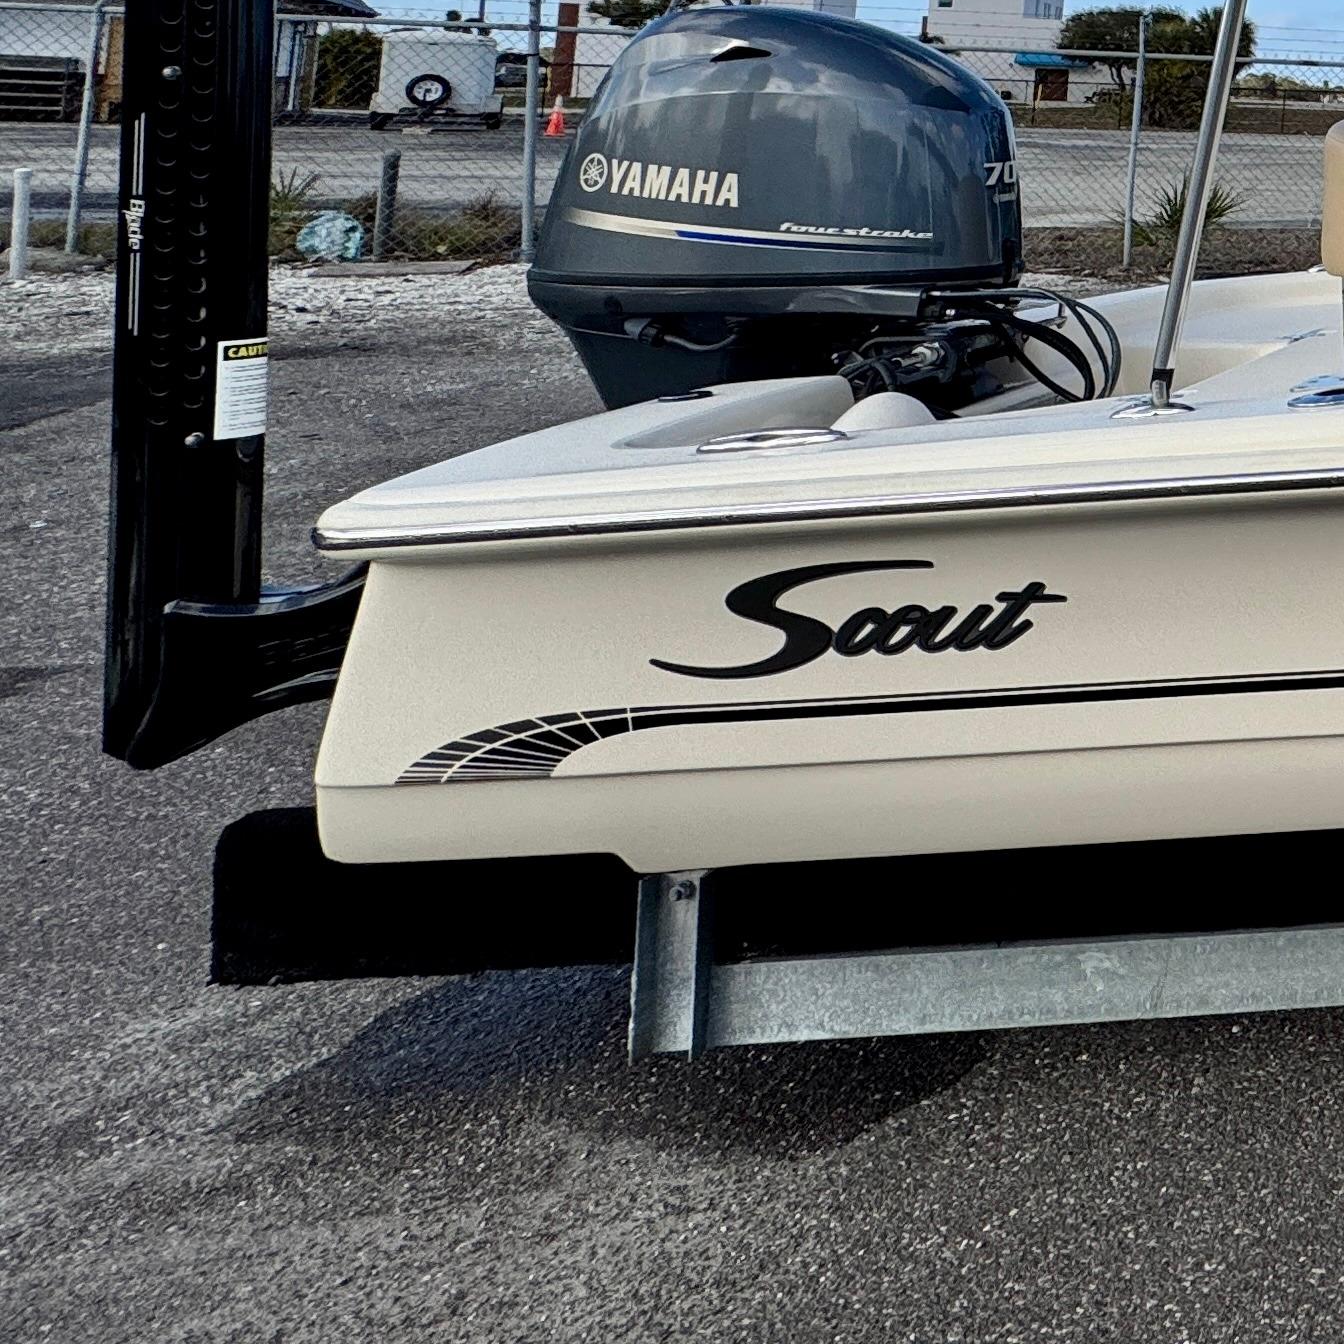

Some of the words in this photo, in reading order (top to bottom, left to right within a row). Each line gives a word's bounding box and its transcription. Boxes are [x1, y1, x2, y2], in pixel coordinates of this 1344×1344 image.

[610, 158, 739, 208] YAMAHA
[983, 160, 1016, 186] 70
[121, 199, 146, 250] Blade
[649, 559, 1068, 679] Scout
